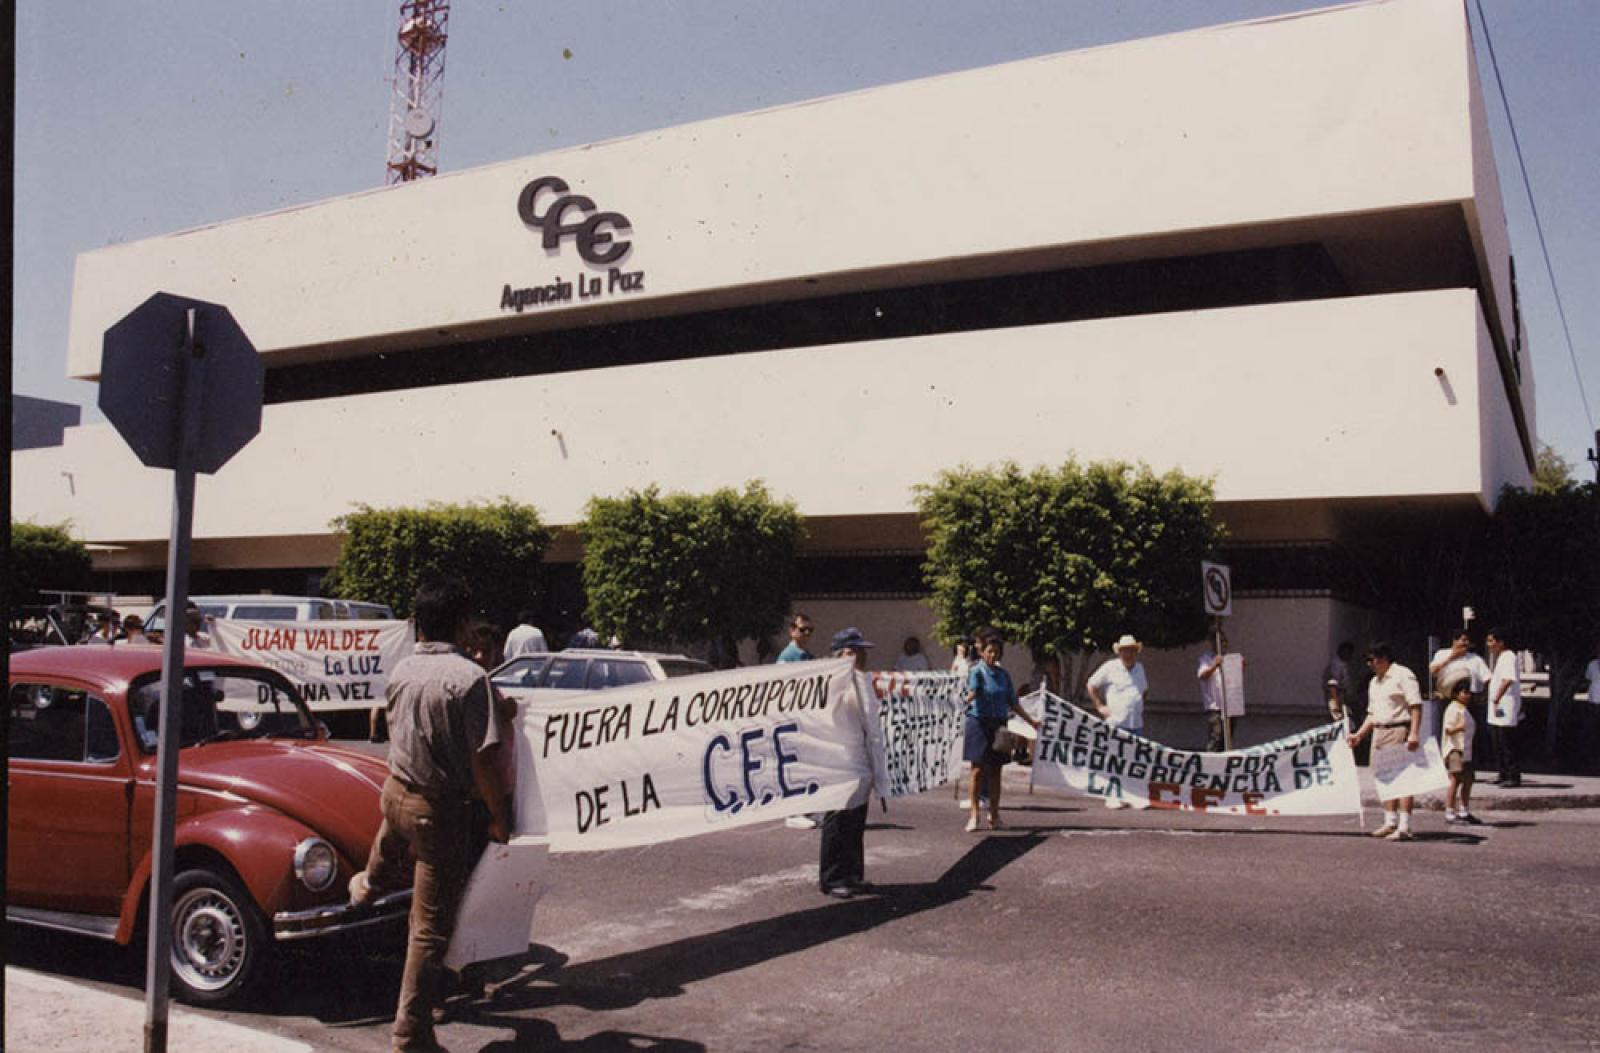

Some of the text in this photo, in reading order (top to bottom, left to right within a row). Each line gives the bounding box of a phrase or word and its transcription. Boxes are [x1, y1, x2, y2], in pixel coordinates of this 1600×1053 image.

[517, 175, 633, 264] CFE
[500, 266, 645, 312] Agencia La Paz
[241, 627, 382, 651] JUAN VALDEZ
[324, 655, 345, 676] La
[348, 655, 385, 676] LUZ
[336, 681, 376, 701] VEZ
[542, 702, 633, 759] FUERA
[642, 695, 678, 737] LA
[684, 673, 834, 728] CORRUPCION
[703, 722, 820, 815] C.F.E.
[1039, 740, 1334, 793] INCONGRUENCIA DE
[1042, 716, 1202, 772] ELECTRICA
[1224, 753, 1279, 775] POR
[1291, 745, 1330, 769] LA
[574, 772, 662, 835] DE LA
[1087, 772, 1122, 798] LA
